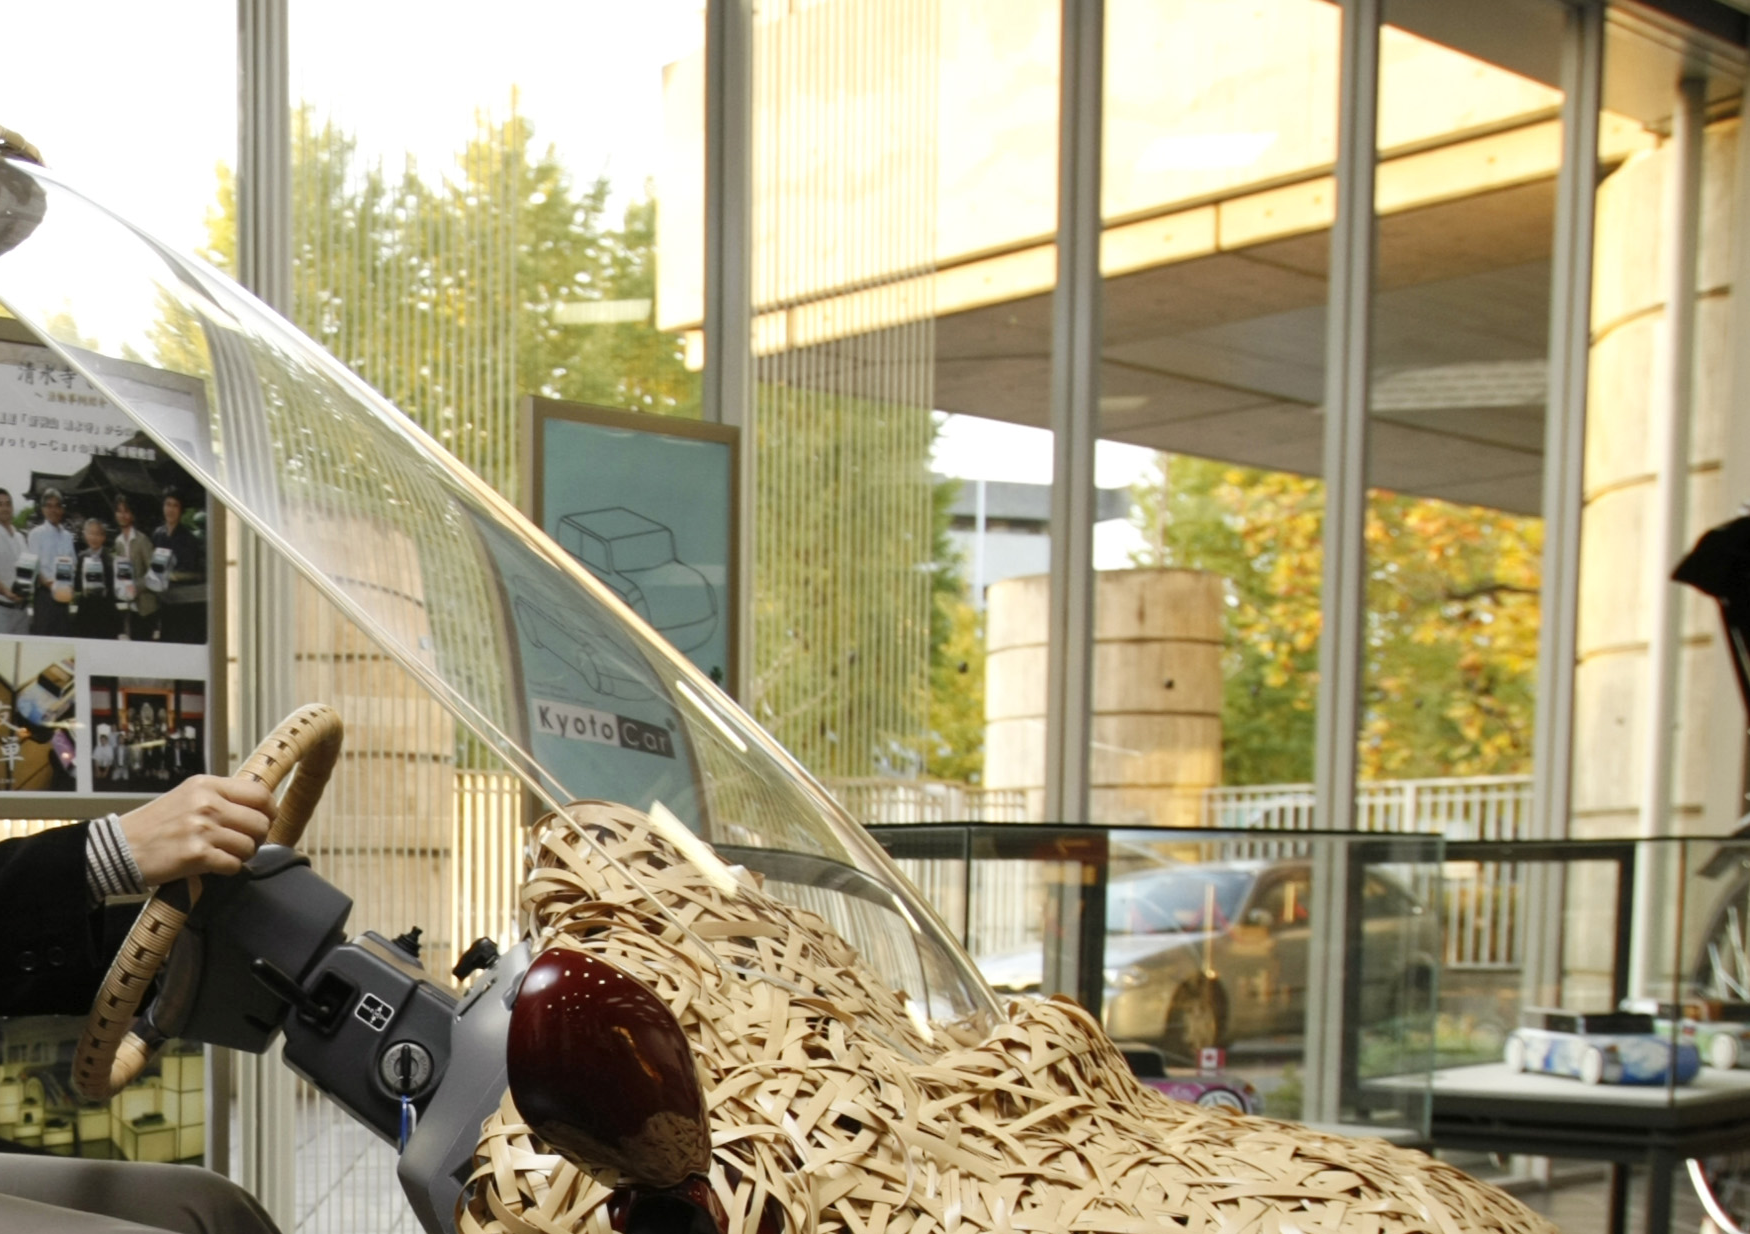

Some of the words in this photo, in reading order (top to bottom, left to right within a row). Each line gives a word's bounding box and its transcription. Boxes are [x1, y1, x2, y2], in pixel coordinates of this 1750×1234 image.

[17, 360, 94, 389] 清水寺
[538, 704, 615, 741] Kyoto
